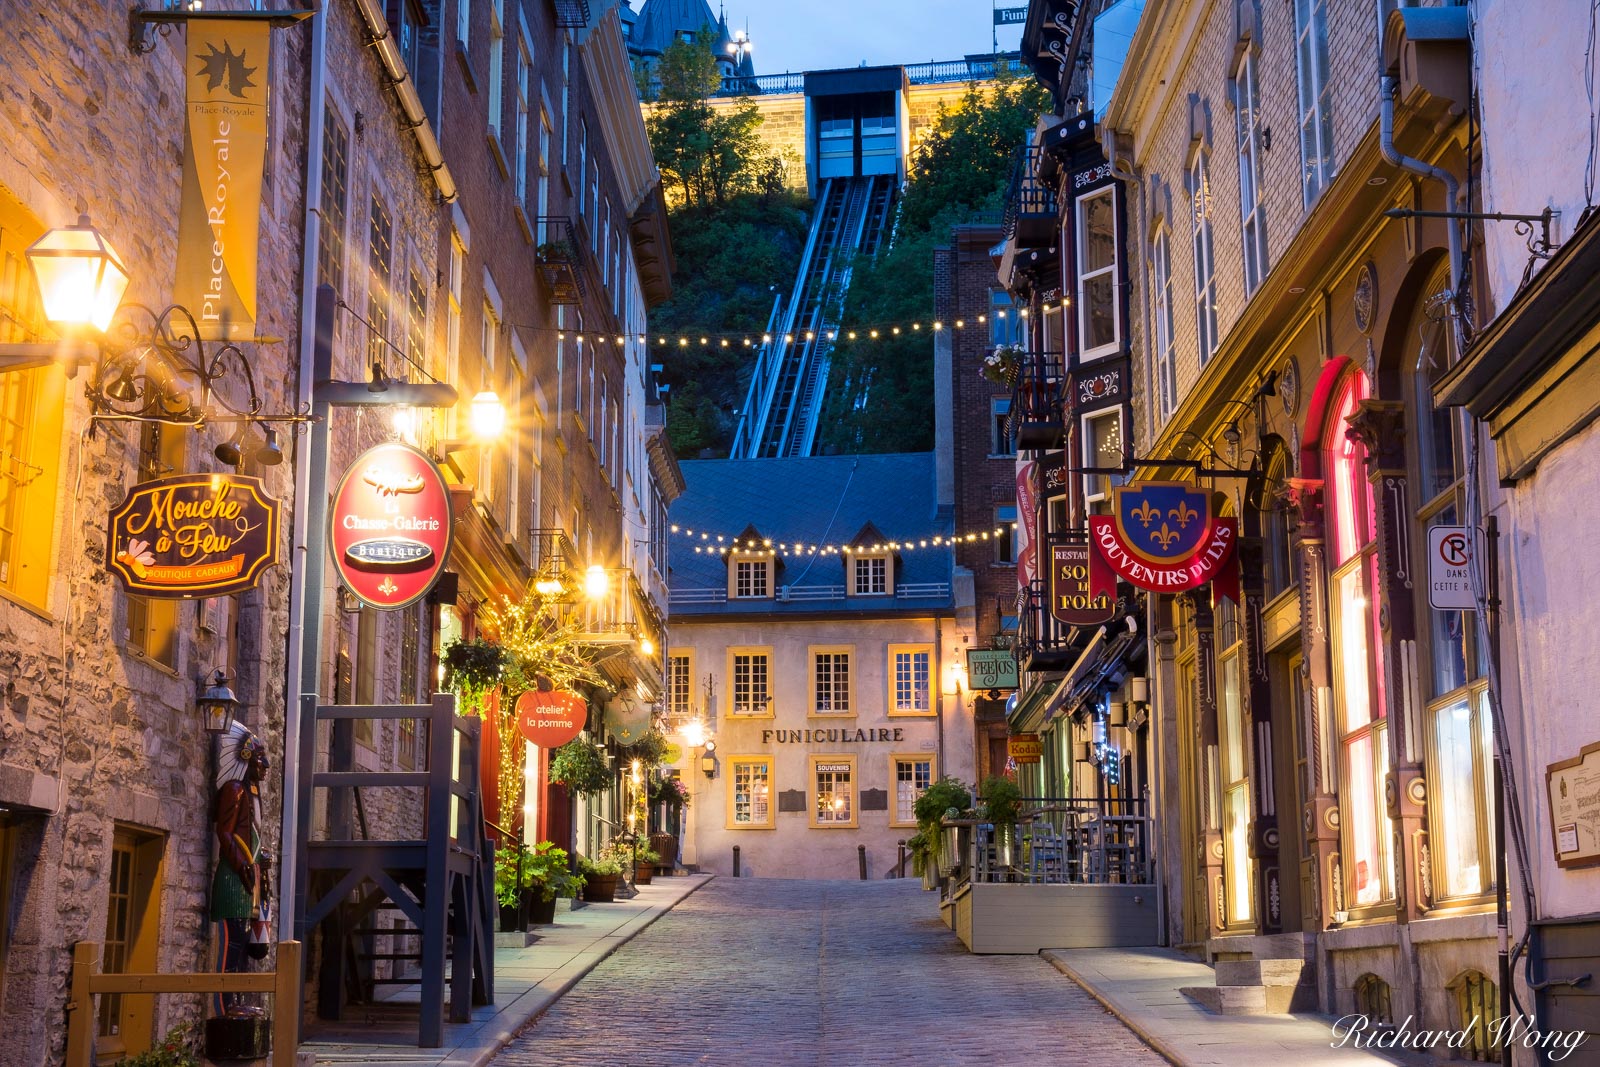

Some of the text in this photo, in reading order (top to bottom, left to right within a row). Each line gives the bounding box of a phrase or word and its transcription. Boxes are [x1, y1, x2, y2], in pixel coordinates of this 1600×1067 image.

[195, 105, 255, 116] Place-Royale
[202, 120, 231, 321] Place-Royale
[126, 481, 242, 535] Mouche
[343, 514, 440, 531] Chasse-Galerie
[156, 522, 232, 558] à Feu
[359, 545, 422, 558] Boutique
[1096, 524, 1231, 586] SOUVENIRS DU LYS
[148, 563, 236, 578] BOUTIQUE CADEAUX
[1061, 565, 1089, 580] SO
[1446, 569, 1468, 578] DANS
[1434, 582, 1458, 591] CETTE
[535, 704, 565, 715] atelier
[527, 717, 573, 729] la pomme
[762, 728, 905, 744] FUNICULAIRE
[1011, 744, 1043, 754] Kodak
